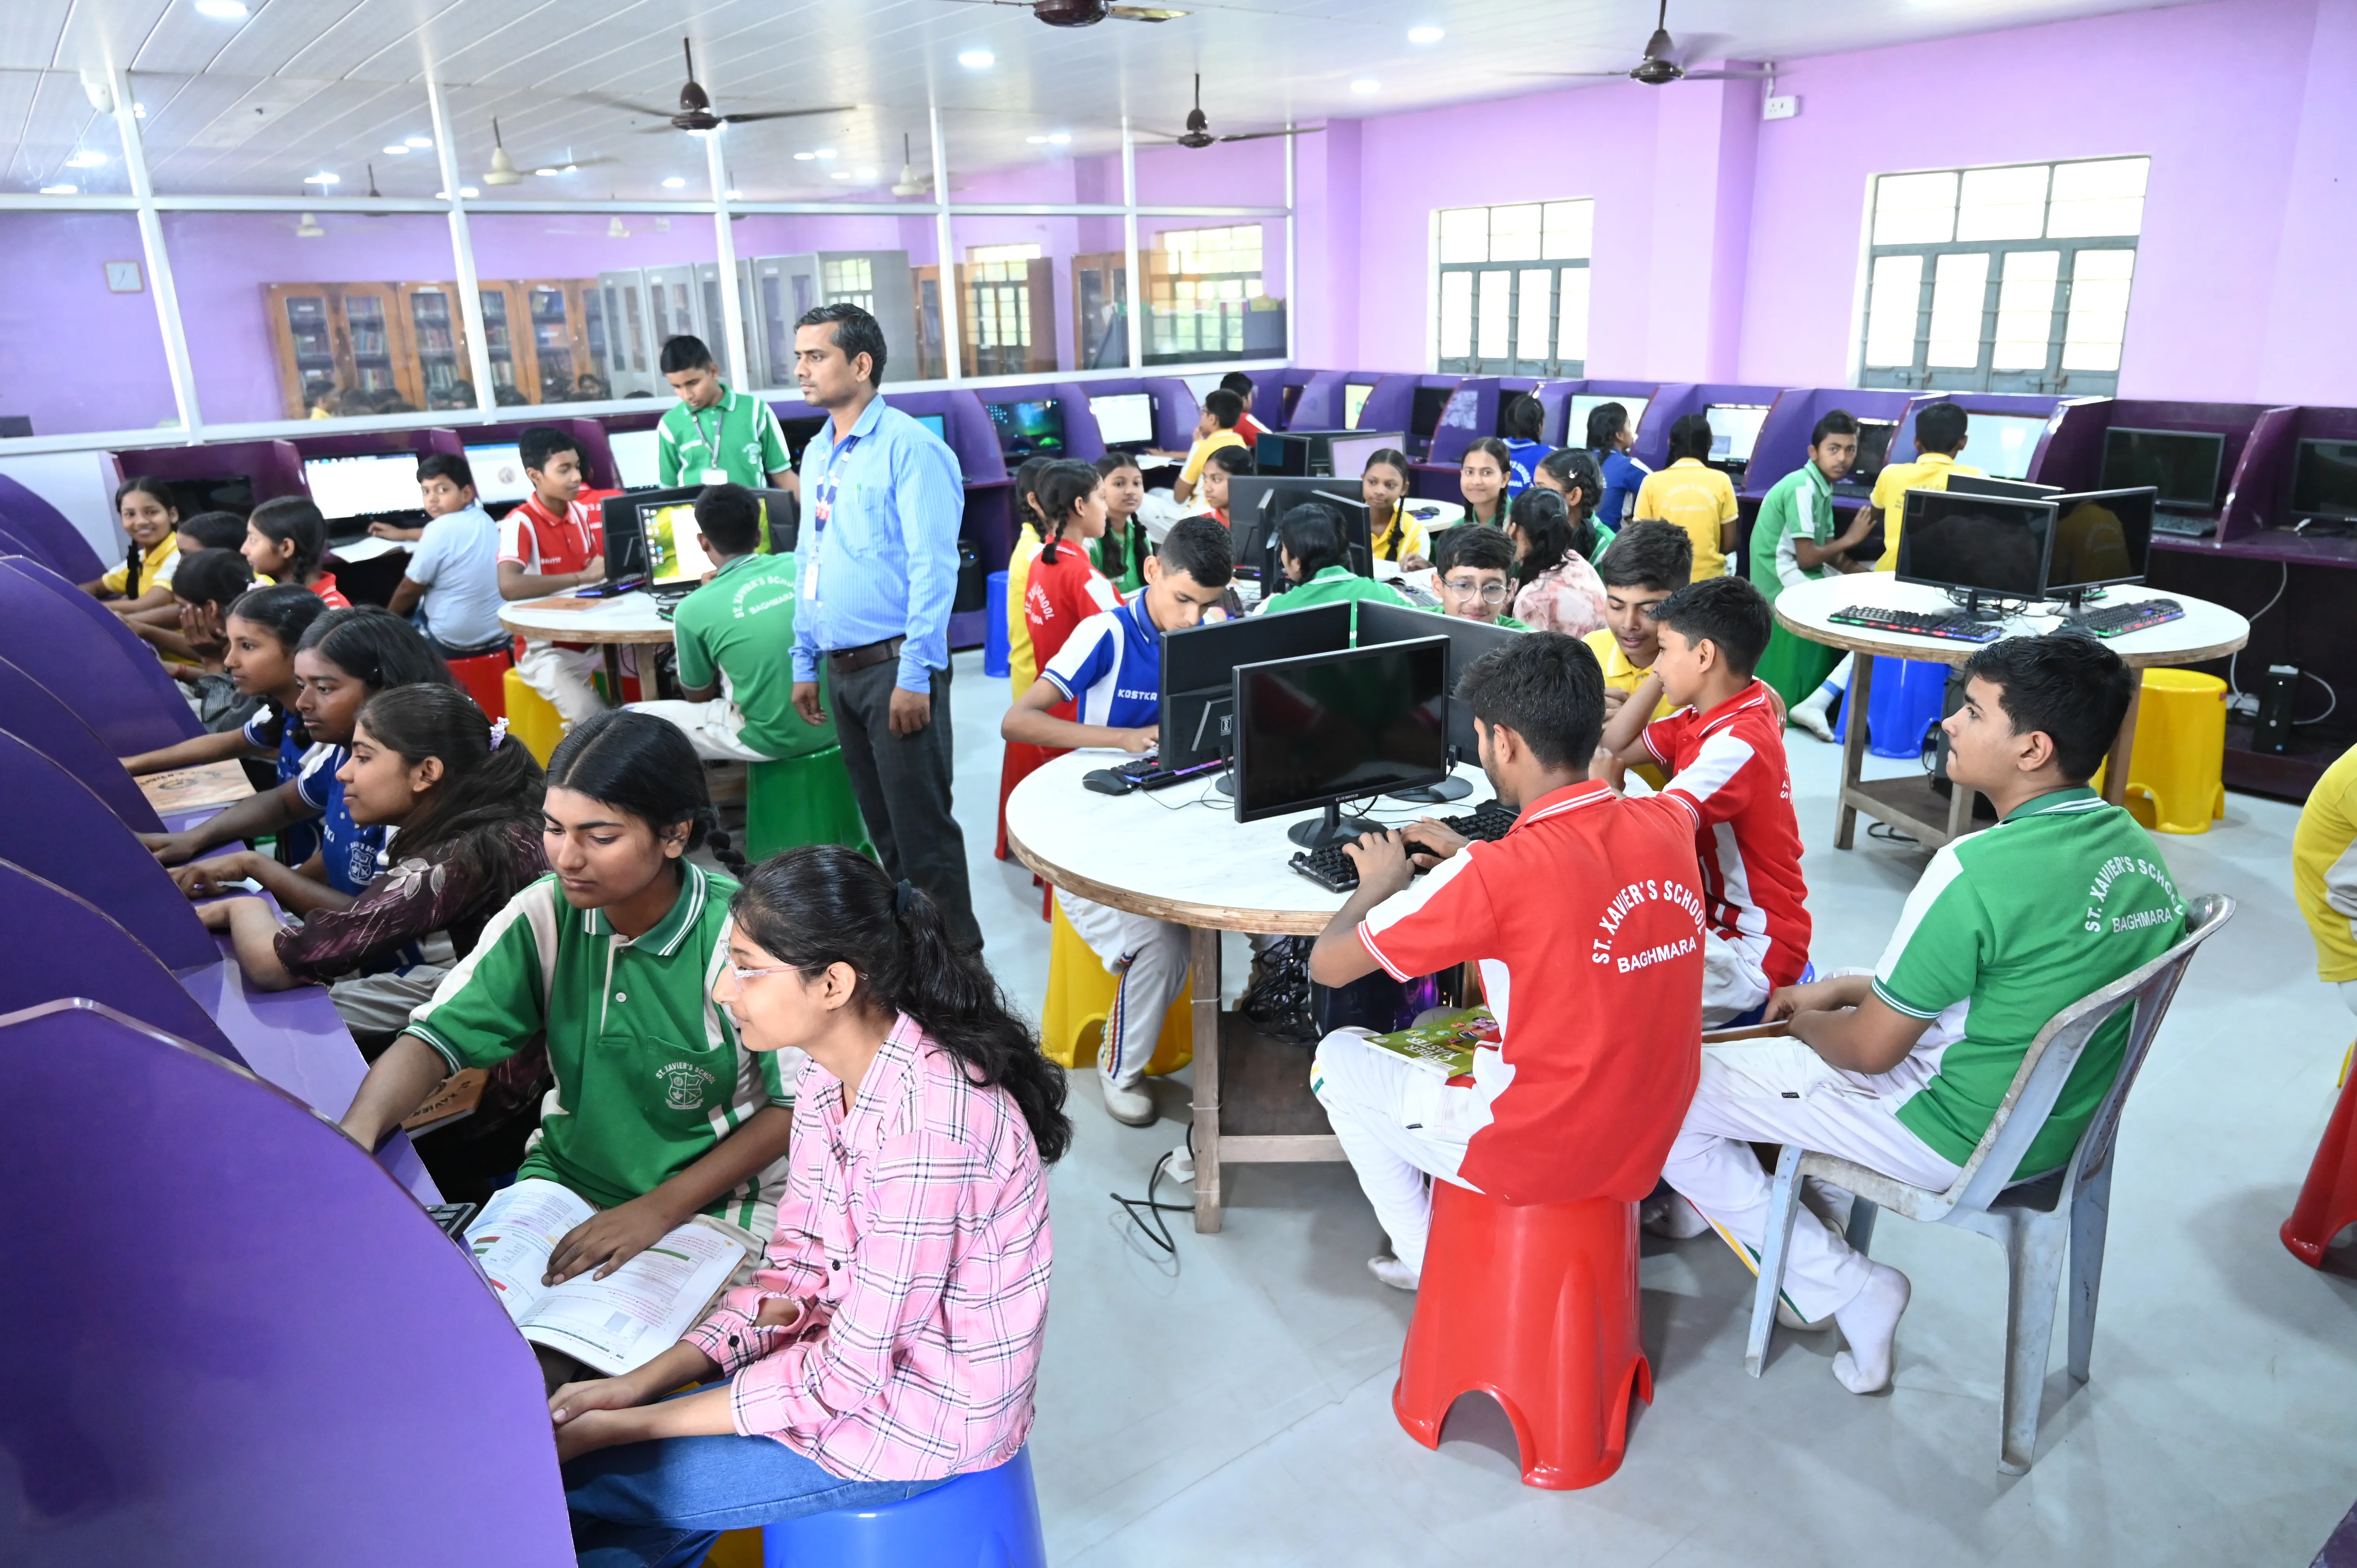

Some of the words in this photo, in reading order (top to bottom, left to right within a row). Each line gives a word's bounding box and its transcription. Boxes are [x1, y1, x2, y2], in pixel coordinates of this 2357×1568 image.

[1118, 689, 1157, 701] KOSTKA
[2090, 856, 2134, 903] XAVIER'S
[2138, 859, 2183, 915] SCHOOL
[1599, 879, 1658, 935] XAVIER'S
[1663, 880, 1706, 935] SCHOOL
[2085, 907, 2102, 932] ST.
[2112, 908, 2173, 933] BAGHMARA
[1592, 939, 1612, 964] ST.
[1617, 936, 1697, 973] BAGHMARA
[1404, 1045, 1453, 1061] CYBER
[1405, 1037, 1462, 1058] MASTER
[664, 1062, 693, 1072] XAVIER'S
[695, 1067, 716, 1084] SCHOOL
